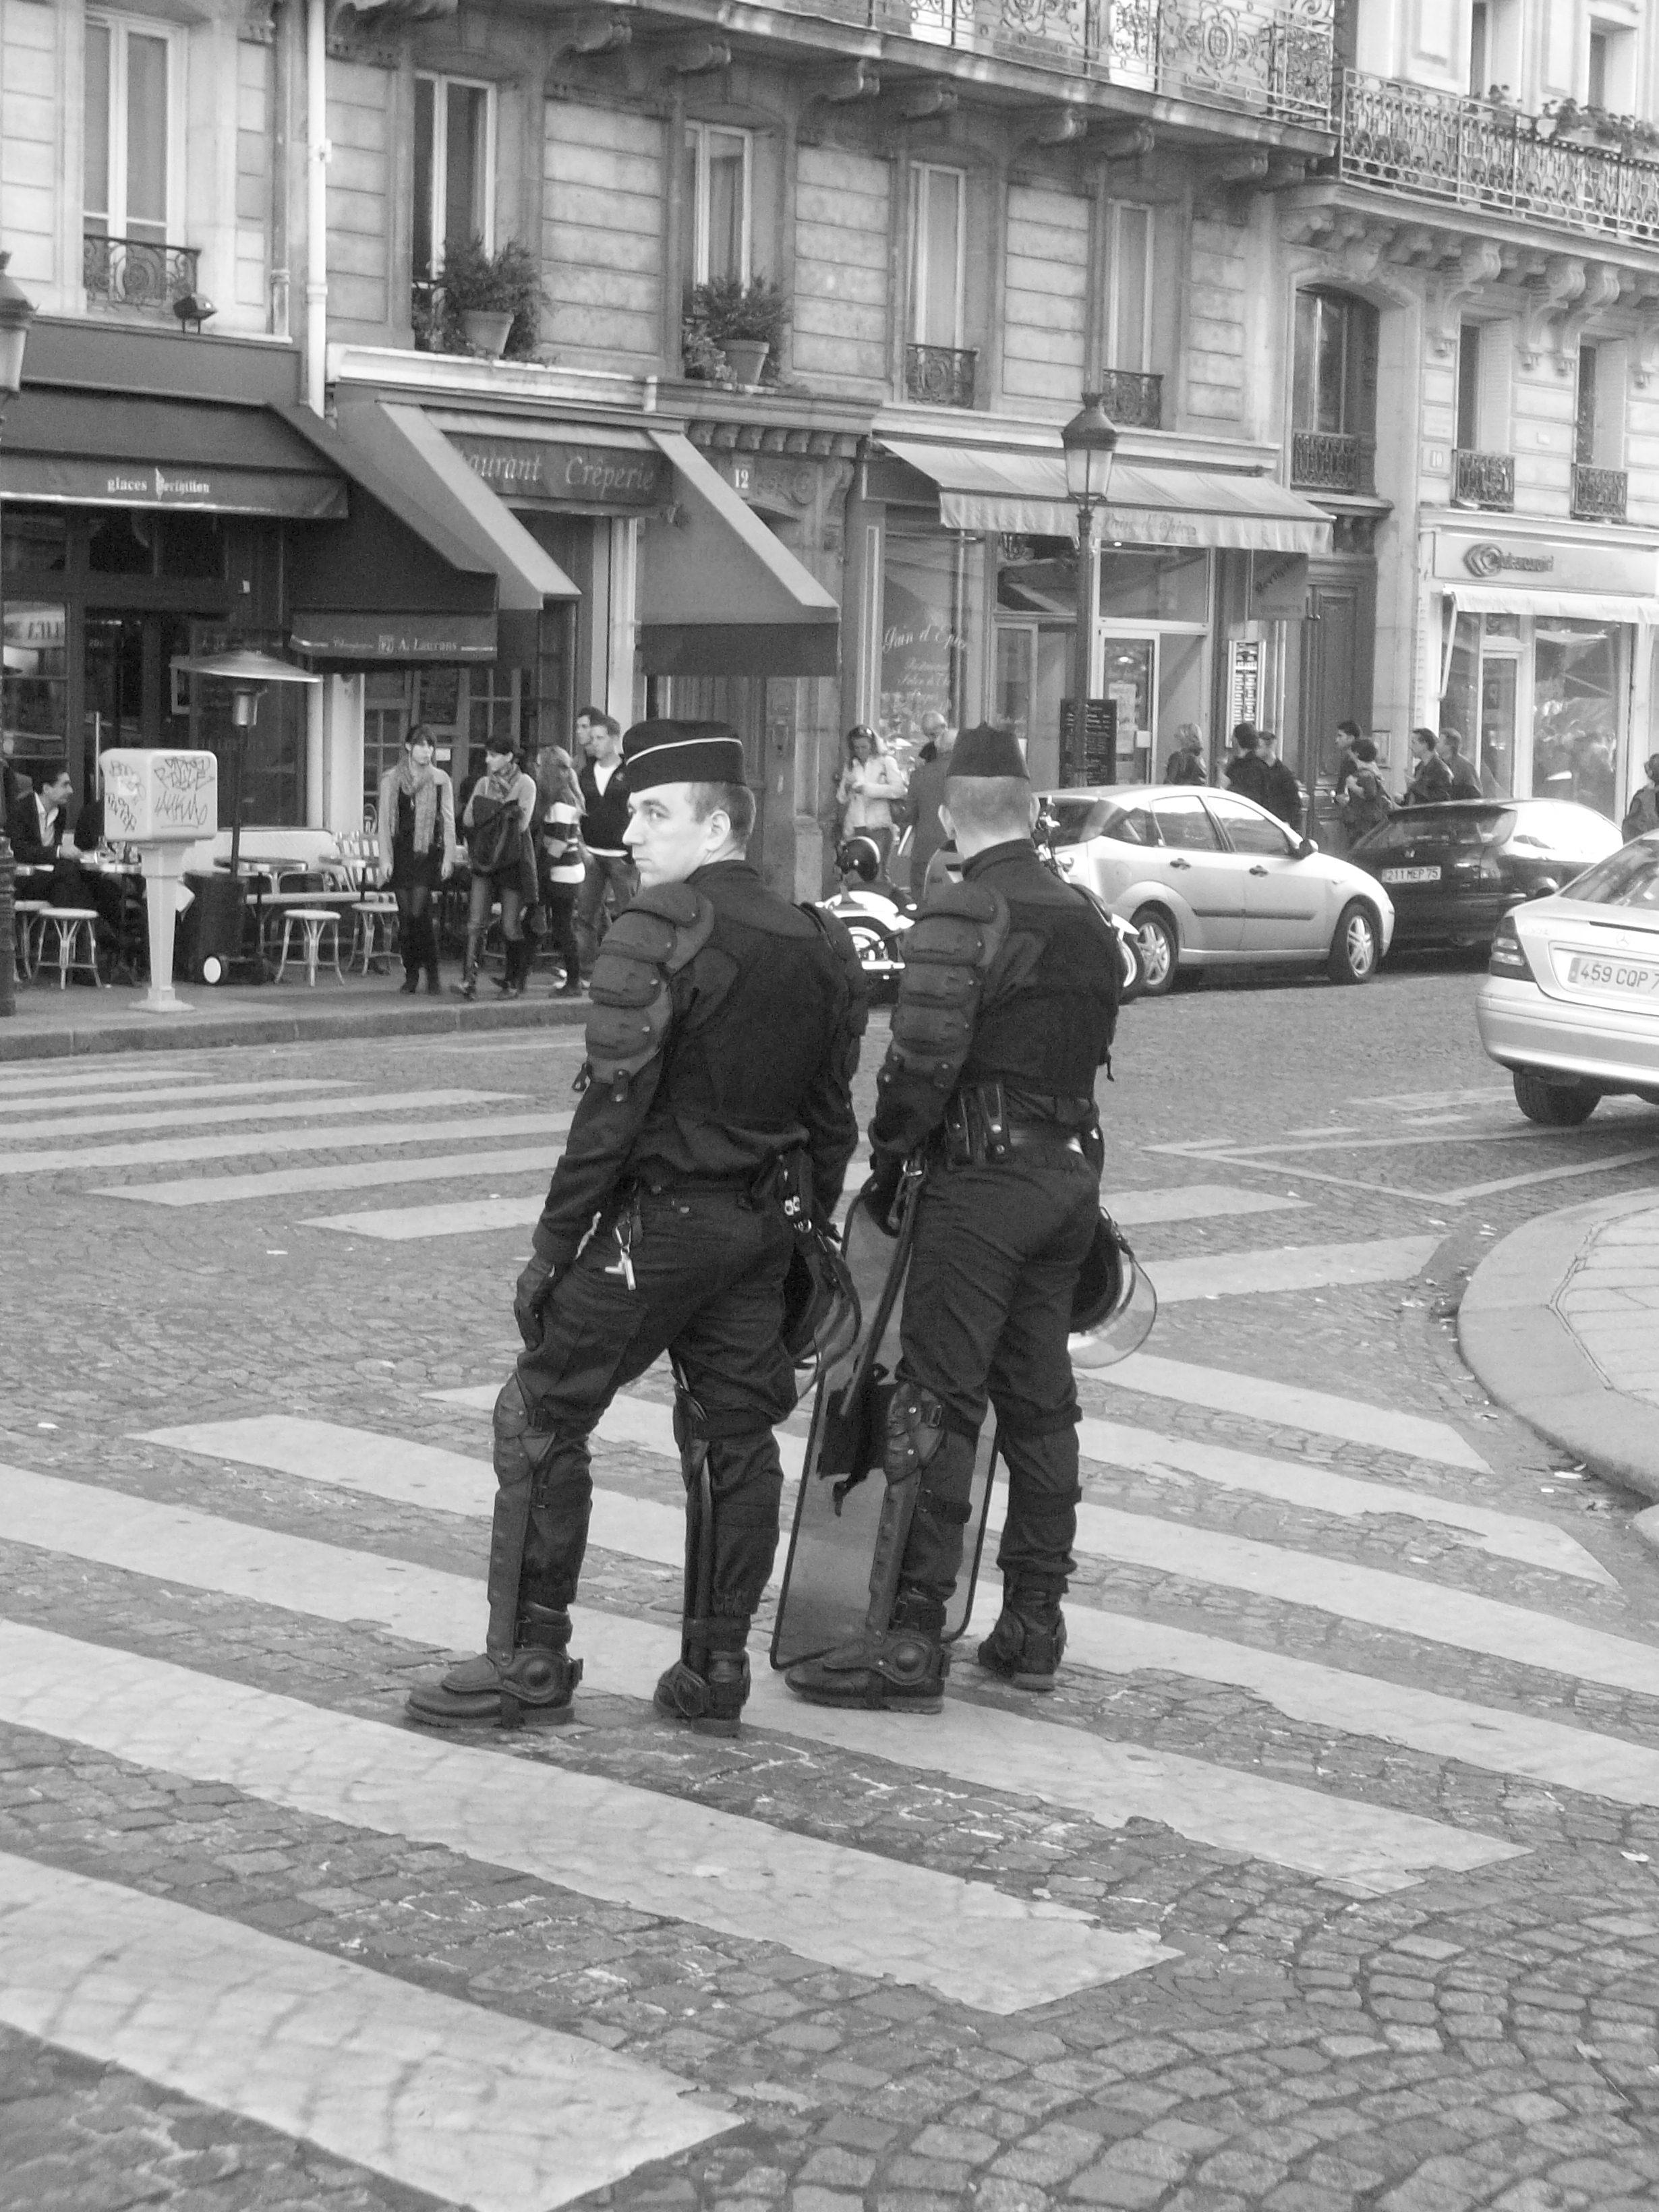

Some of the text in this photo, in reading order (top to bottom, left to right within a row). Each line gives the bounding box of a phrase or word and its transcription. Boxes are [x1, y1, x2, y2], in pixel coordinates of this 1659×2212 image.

[107, 476, 147, 494] glaces
[735, 469, 749, 488] 12
[1580, 964, 1612, 983] 459
[1615, 968, 1648, 988] CQP
